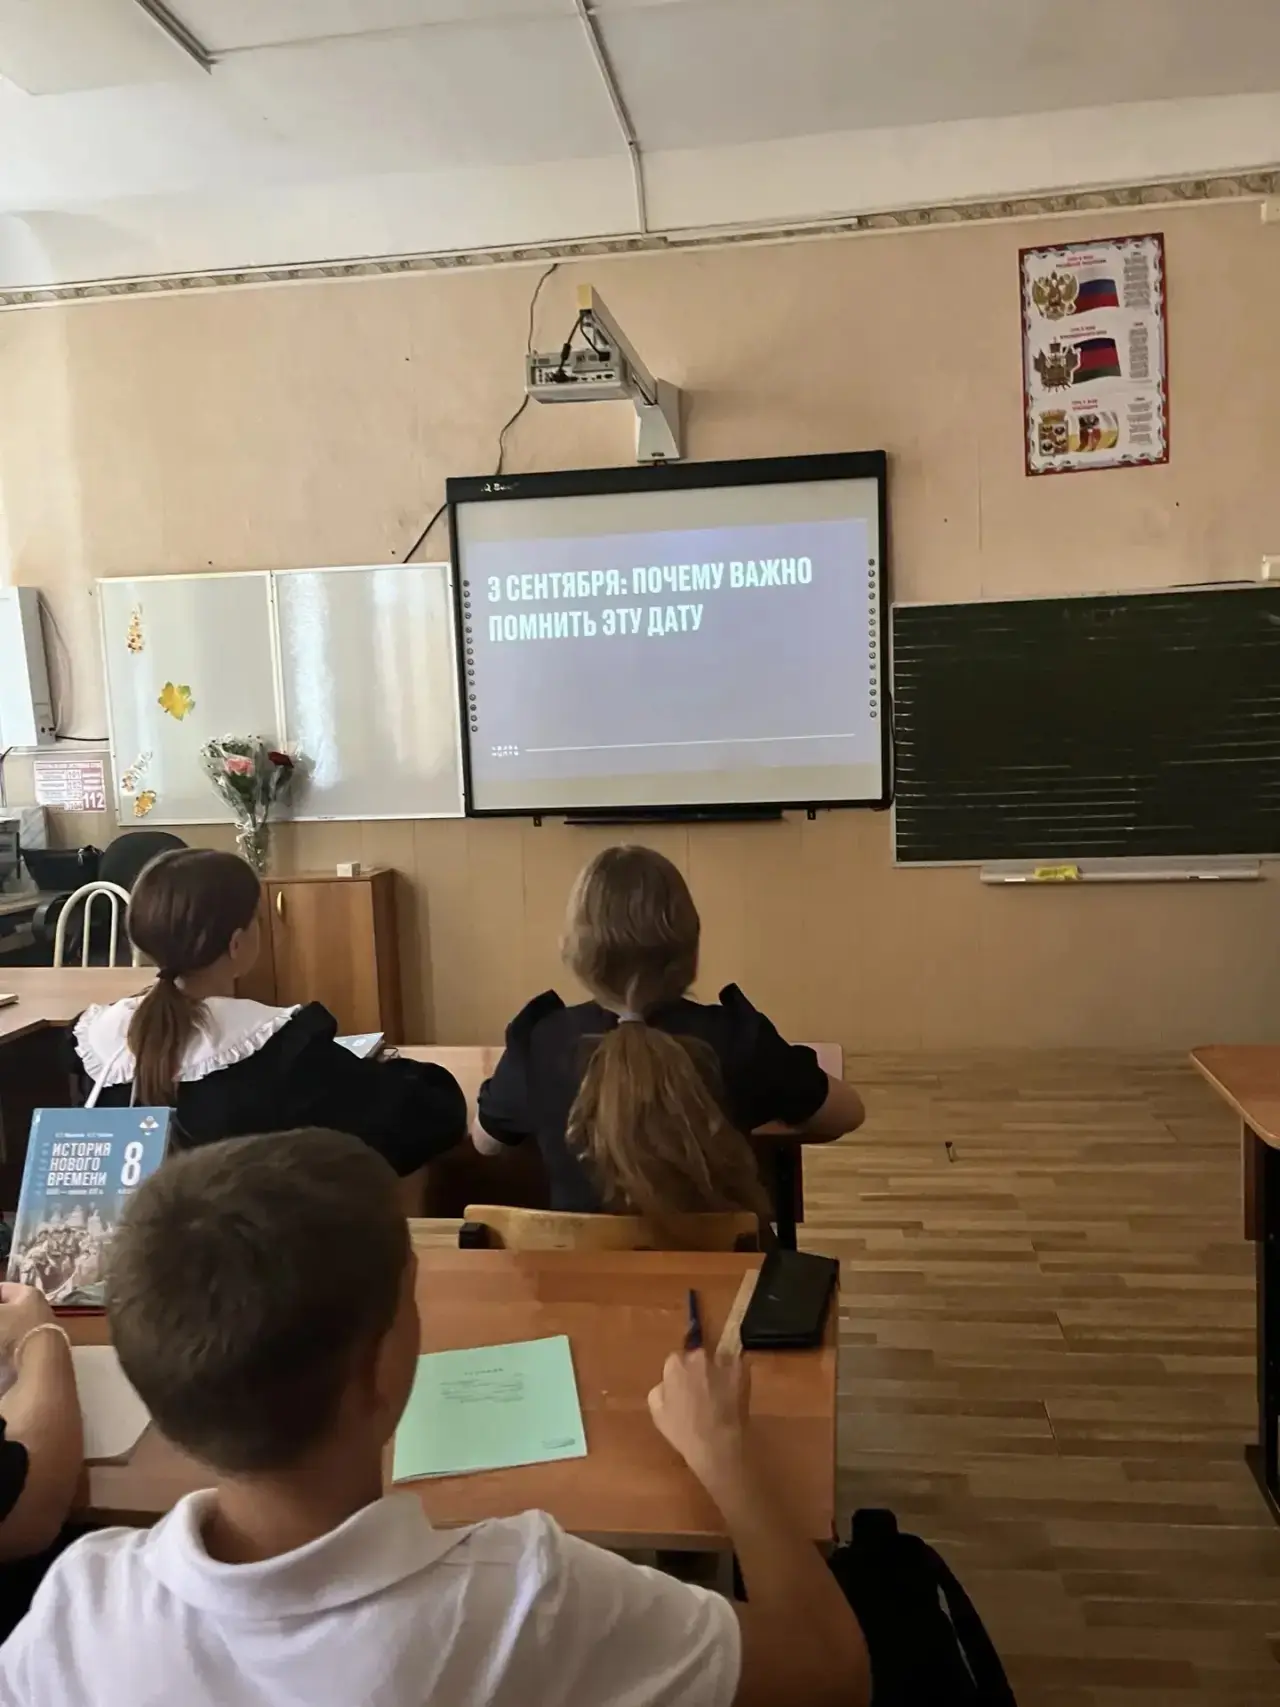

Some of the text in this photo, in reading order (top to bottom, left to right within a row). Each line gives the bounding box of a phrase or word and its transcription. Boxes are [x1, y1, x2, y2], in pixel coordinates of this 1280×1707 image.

[487, 556, 813, 602] 3 СЕНТЯБРЯ: ПОЧЕМУ ВАЖНО
[488, 603, 704, 642] ПОМНИТЬ ЭТУ ДАТУ
[82, 791, 105, 809] 112
[52, 1142, 112, 1157] ИСТОРИЯ
[50, 1157, 101, 1171] НОВОГО
[121, 1141, 144, 1187] 8
[47, 1172, 107, 1187] ВРЕМЕНИ
